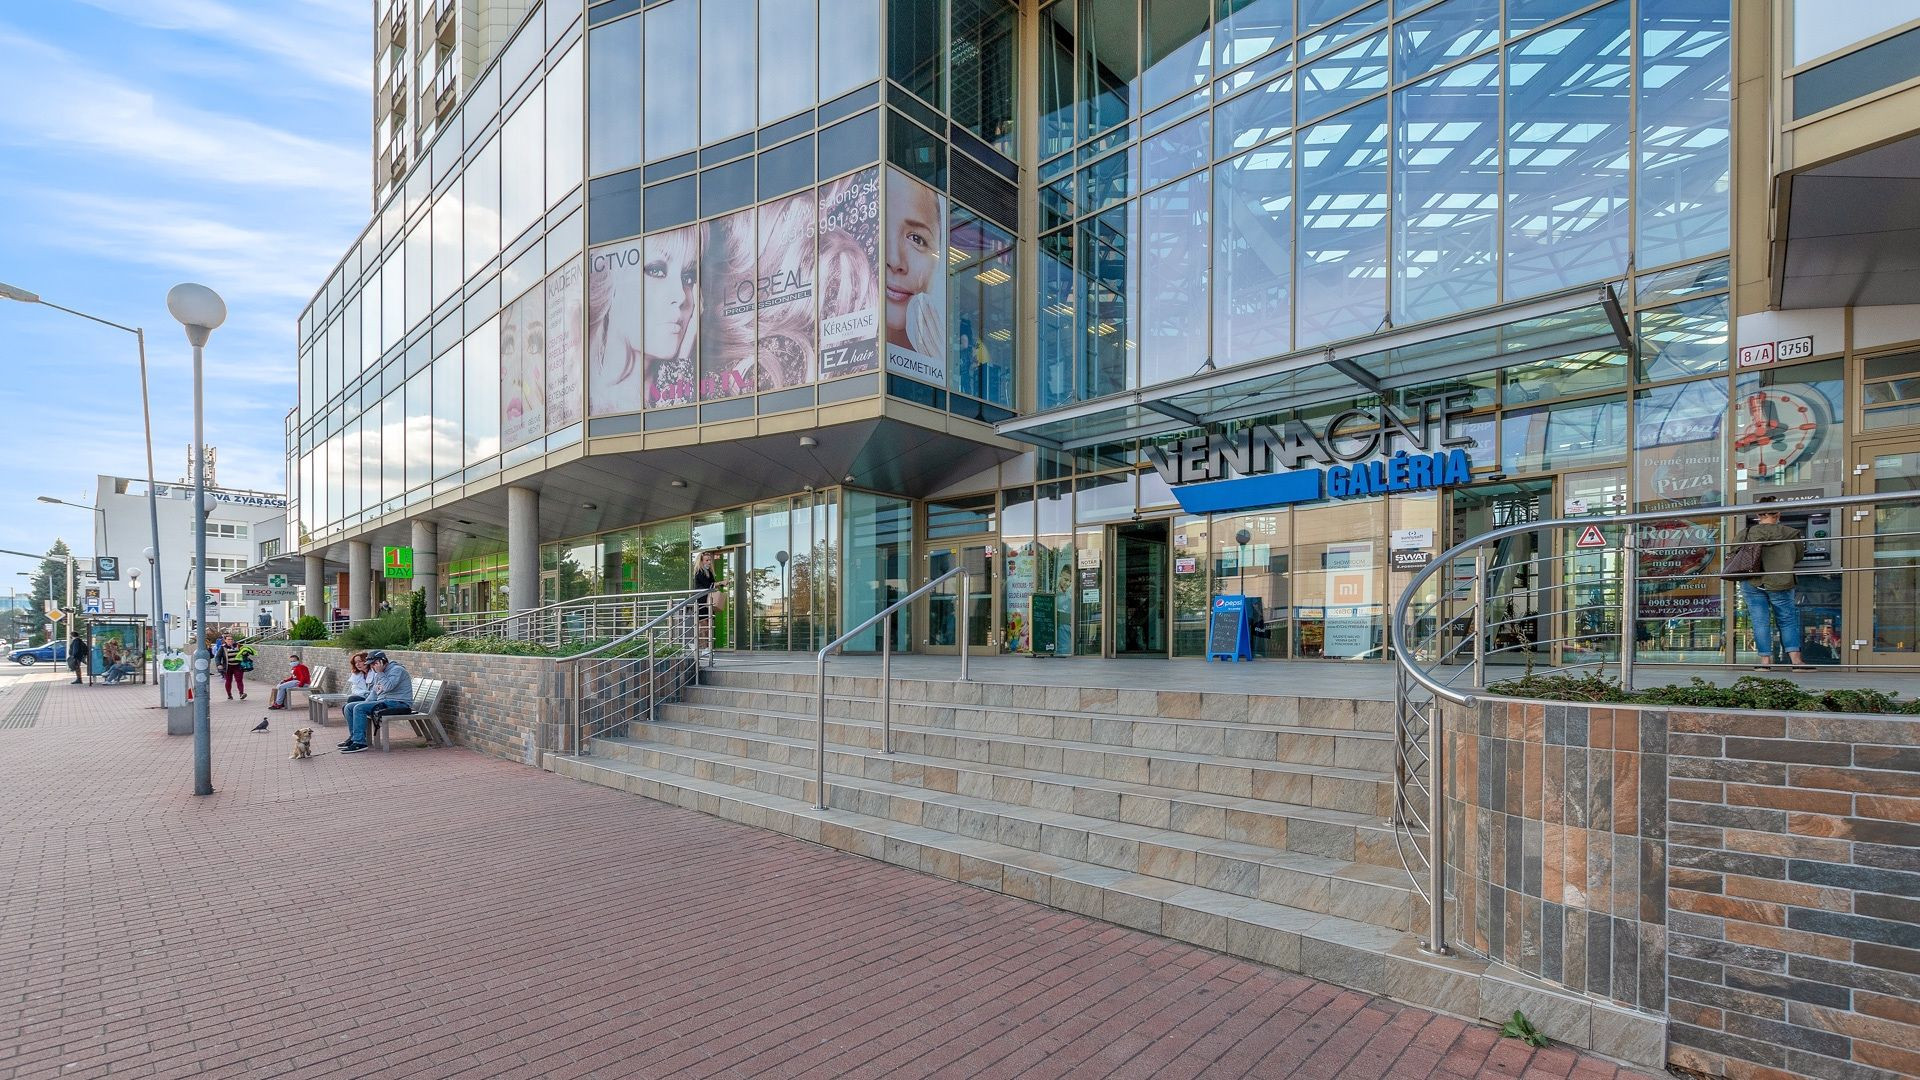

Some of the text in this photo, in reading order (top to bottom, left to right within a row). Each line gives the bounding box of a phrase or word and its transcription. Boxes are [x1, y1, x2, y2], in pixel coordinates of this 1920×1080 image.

[820, 212, 844, 234] 991
[850, 202, 877, 224] 338
[724, 270, 812, 306] L'ORÉAL
[725, 291, 810, 316] PROFESSIONNEL
[824, 314, 872, 336] KÉRASTASE
[824, 348, 874, 370] EZ hair
[1781, 342, 1809, 356] 3756
[890, 353, 944, 380] KOZMETIKA
[1644, 456, 1720, 466] Denné menu
[1327, 448, 1472, 498] GALÉRIA
[1656, 474, 1714, 494] Pizza
[1642, 526, 1720, 540] Rozvoz
[1396, 553, 1428, 562] SWAT
[388, 568, 410, 576] DAY
